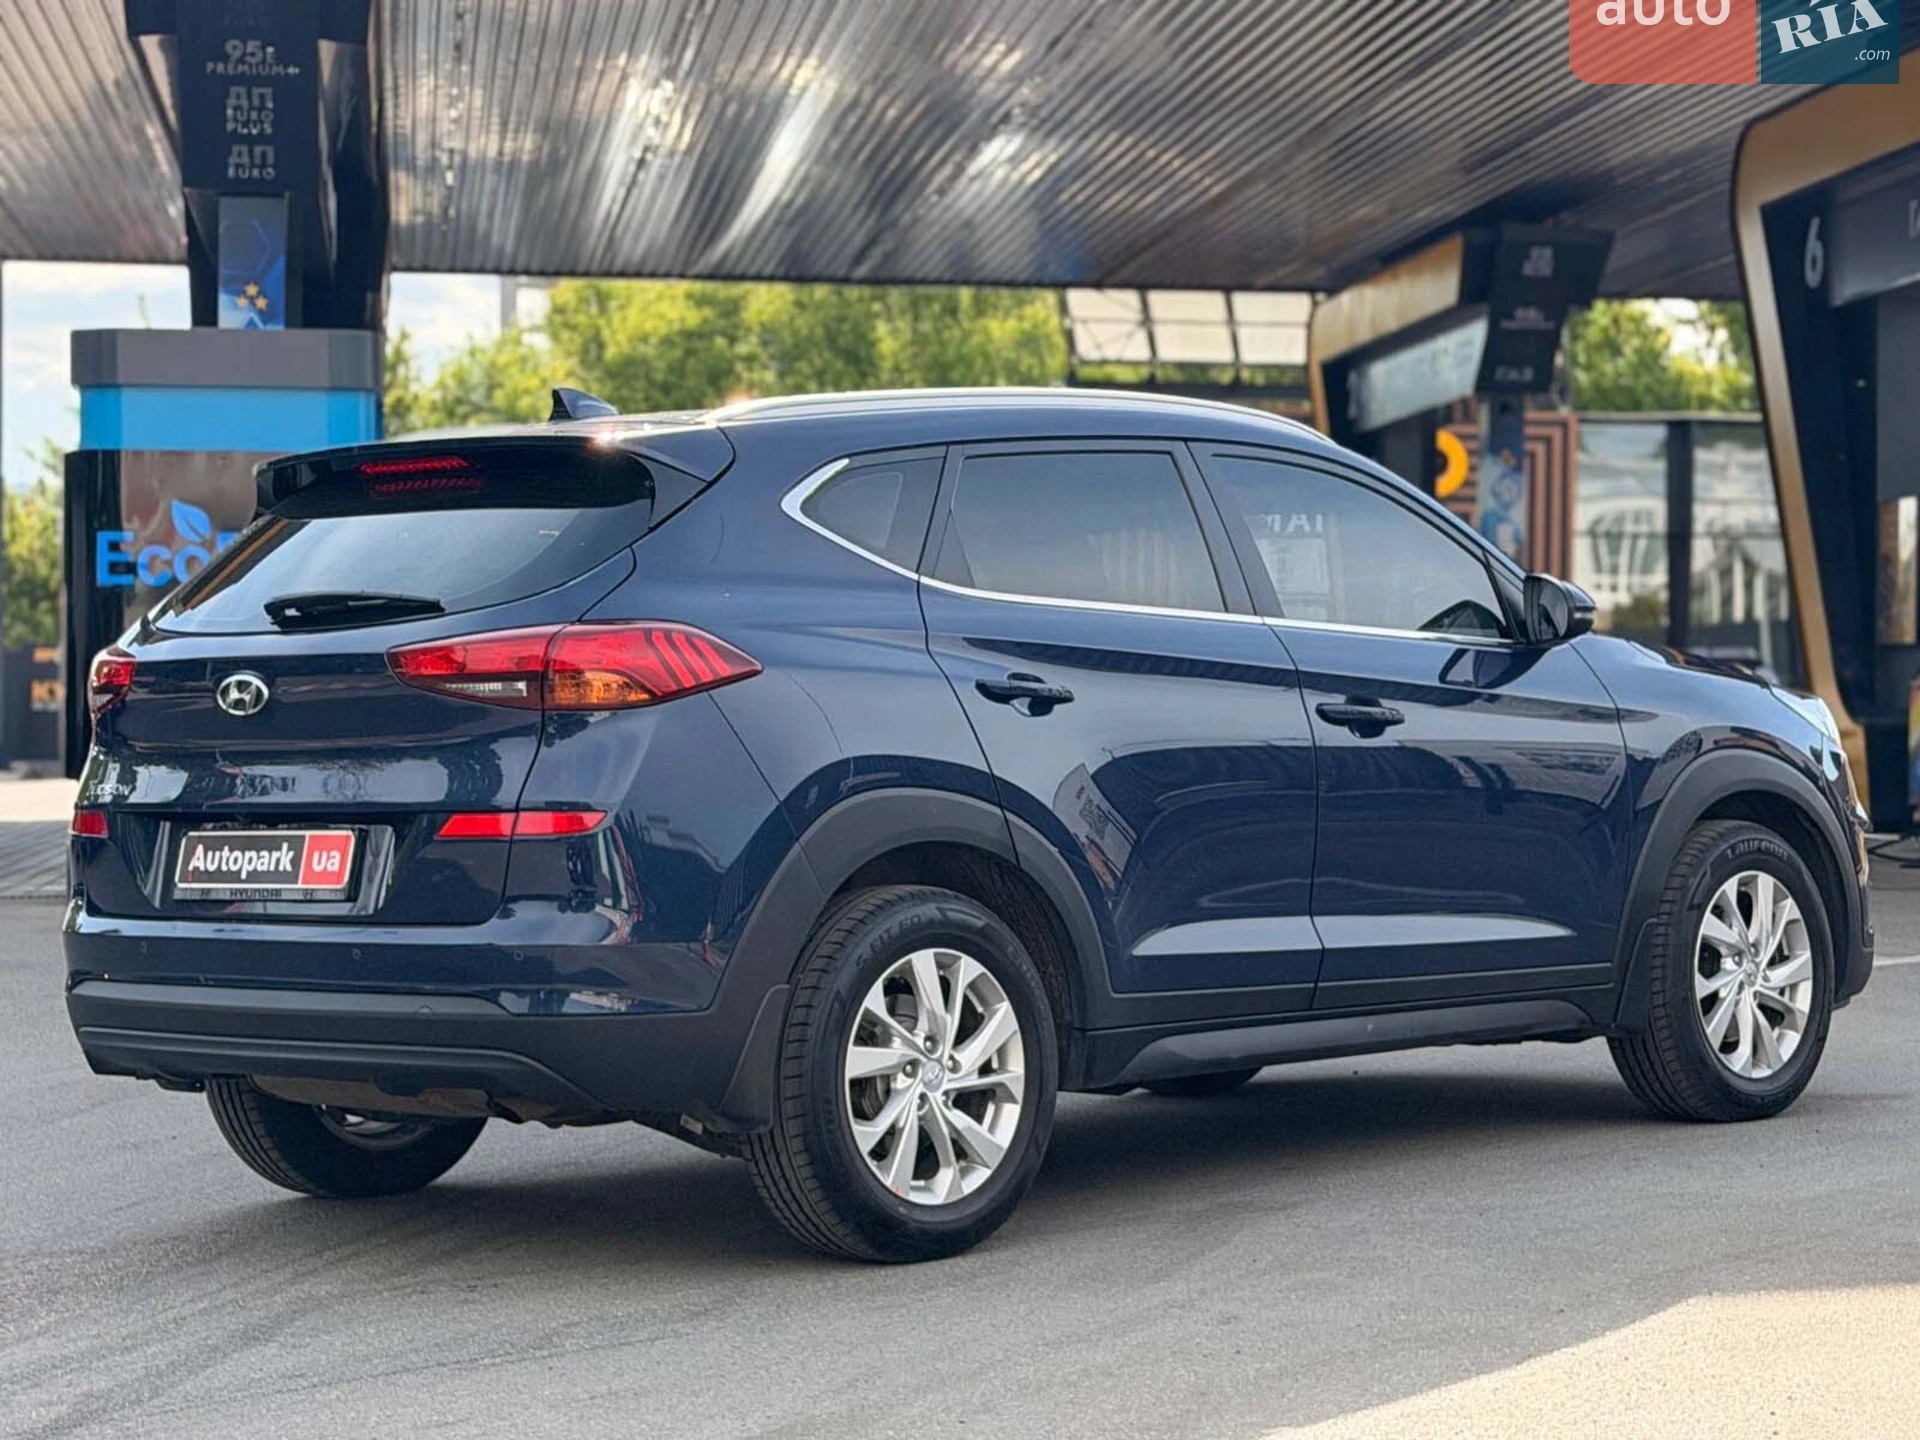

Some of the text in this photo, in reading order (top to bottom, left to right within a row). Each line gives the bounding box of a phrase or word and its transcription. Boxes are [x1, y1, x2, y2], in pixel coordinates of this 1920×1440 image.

[1804, 214, 1824, 289] 6
[96, 530, 242, 587] Eco
[188, 842, 341, 880] Autopark ua
[230, 888, 282, 899] HYUNDAI
